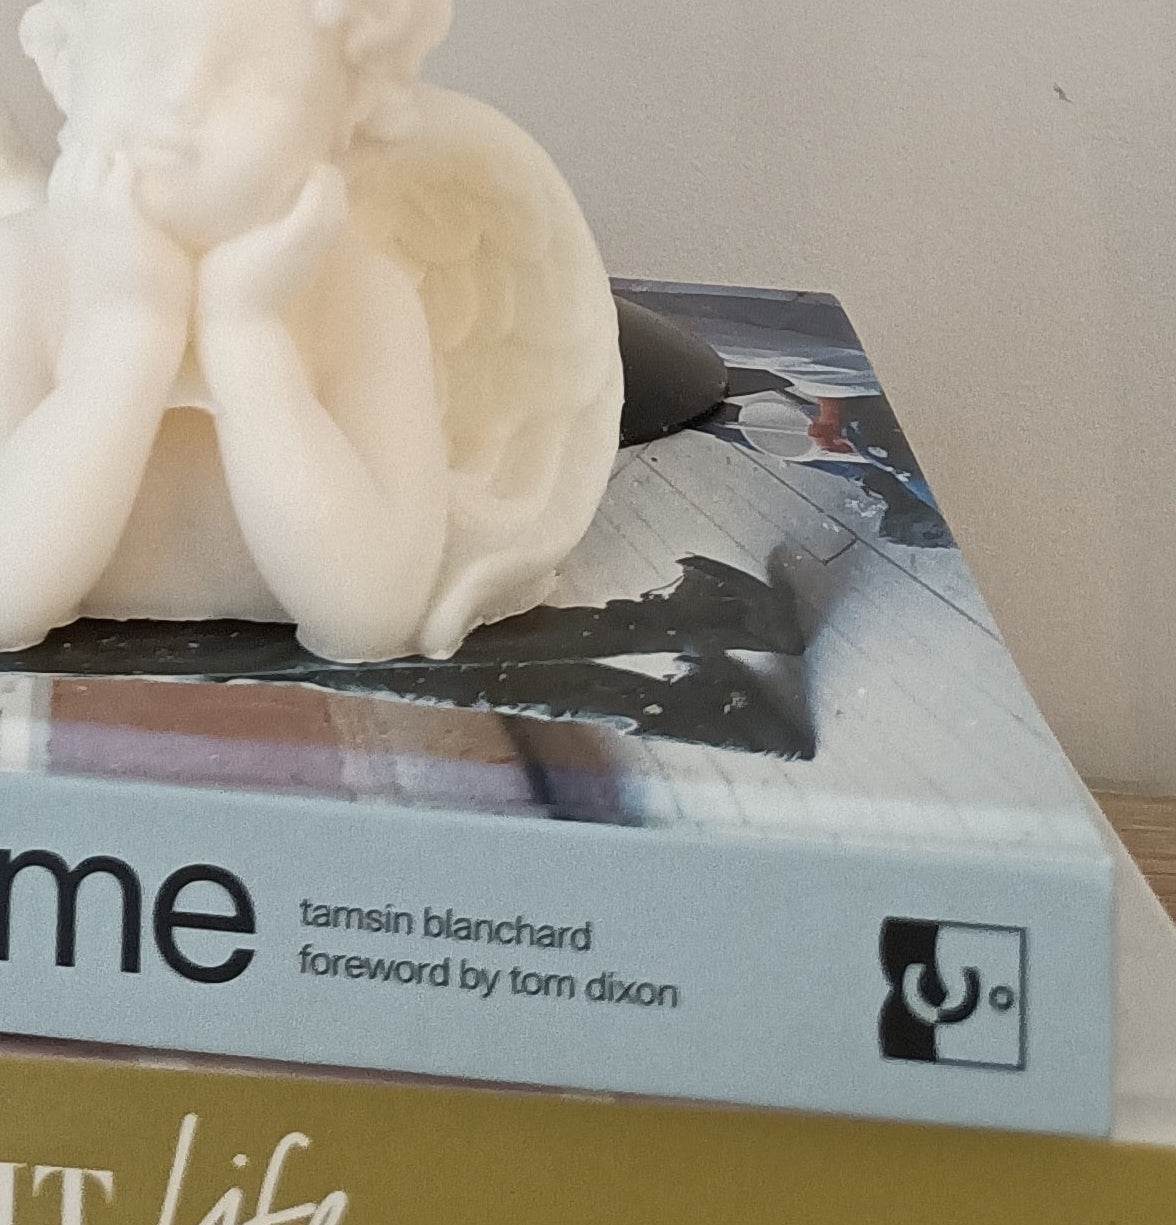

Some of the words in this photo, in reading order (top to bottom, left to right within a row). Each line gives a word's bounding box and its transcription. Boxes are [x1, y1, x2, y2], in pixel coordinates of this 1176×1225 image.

[298, 897, 414, 937] tamsin
[422, 904, 594, 953] blanchard
[297, 942, 451, 989] foreword
[457, 957, 502, 1001] by
[508, 965, 578, 1001] tom
[584, 970, 682, 1009] dixon
